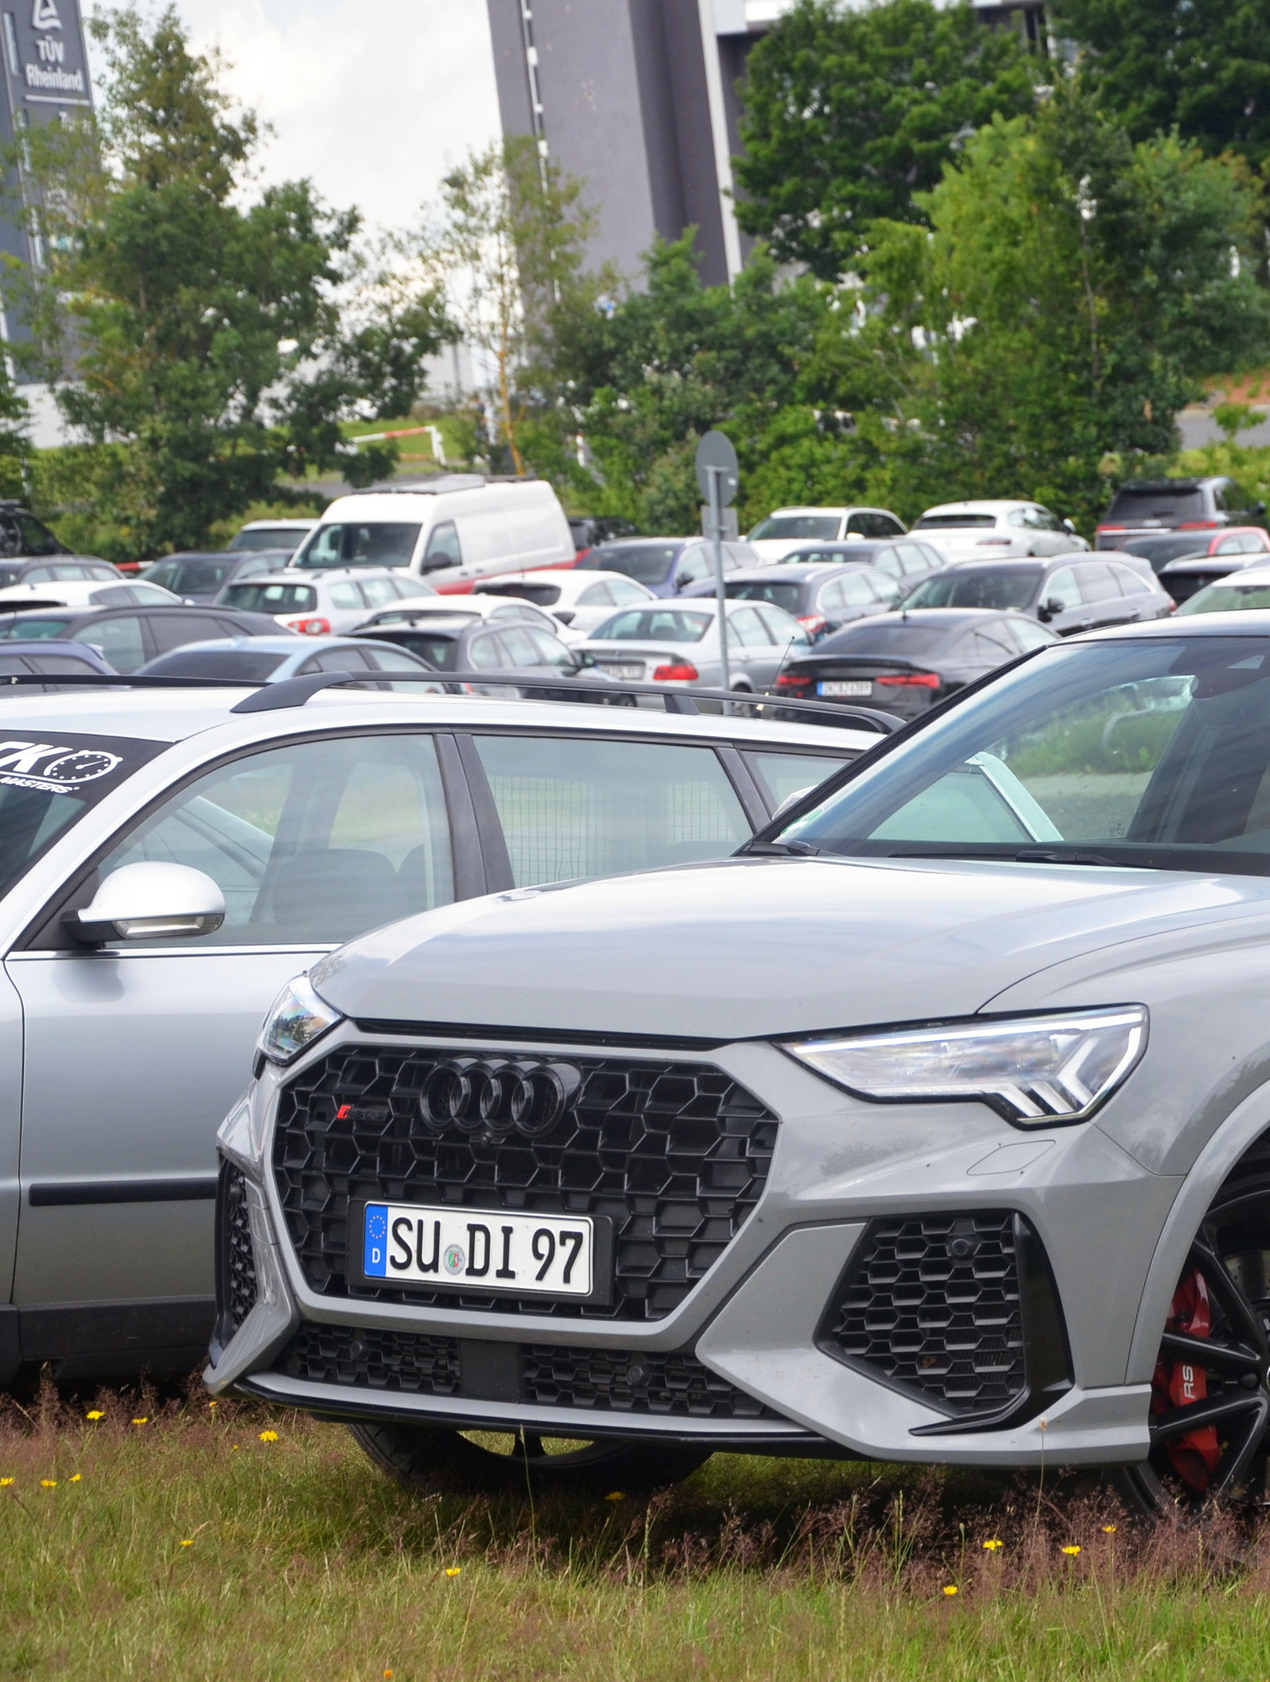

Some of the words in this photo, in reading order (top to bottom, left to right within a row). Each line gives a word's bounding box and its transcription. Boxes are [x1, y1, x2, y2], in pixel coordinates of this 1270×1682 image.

[36, 35, 63, 62] TÜV
[25, 63, 84, 92] Rheinland
[0, 777, 73, 793] MASTERS
[371, 1248, 381, 1264] D
[389, 1216, 441, 1274] SU
[465, 1223, 516, 1279] DI
[531, 1228, 583, 1284] 97
[1183, 1365, 1195, 1399] RS
